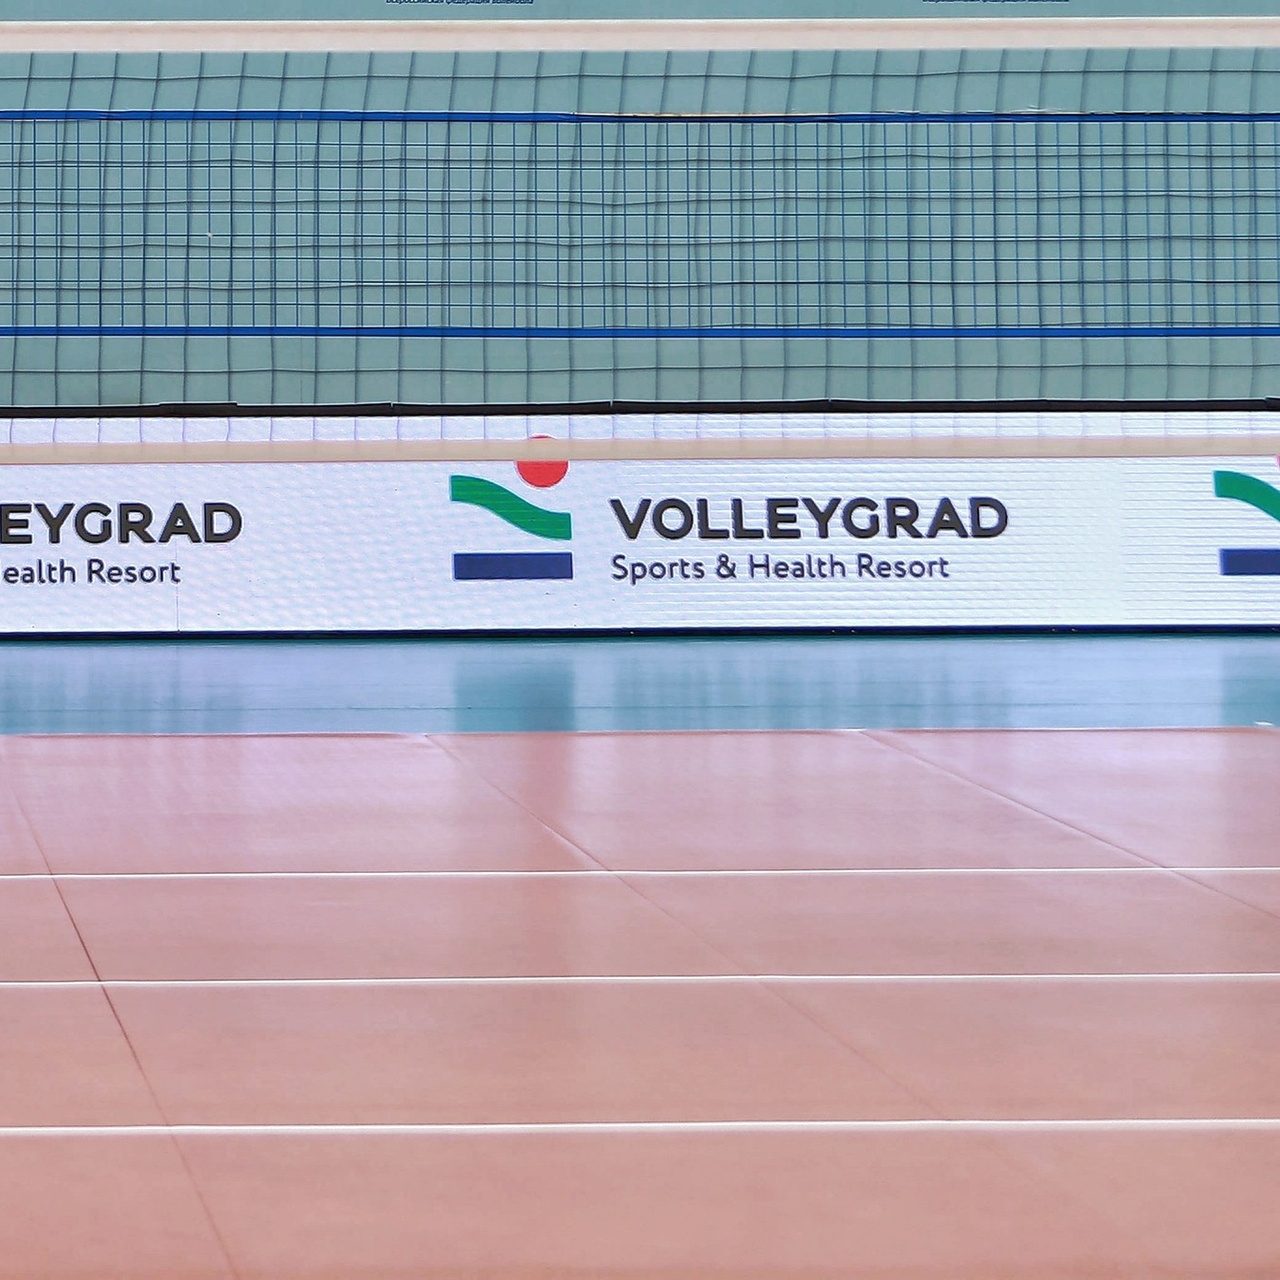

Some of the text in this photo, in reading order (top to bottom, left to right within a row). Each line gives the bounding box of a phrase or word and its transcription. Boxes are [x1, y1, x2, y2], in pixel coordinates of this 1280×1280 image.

[610, 497, 1008, 540] VOLLEYGRAD
[88, 558, 180, 583] Resort
[612, 553, 950, 586] Sports & Health Resort
